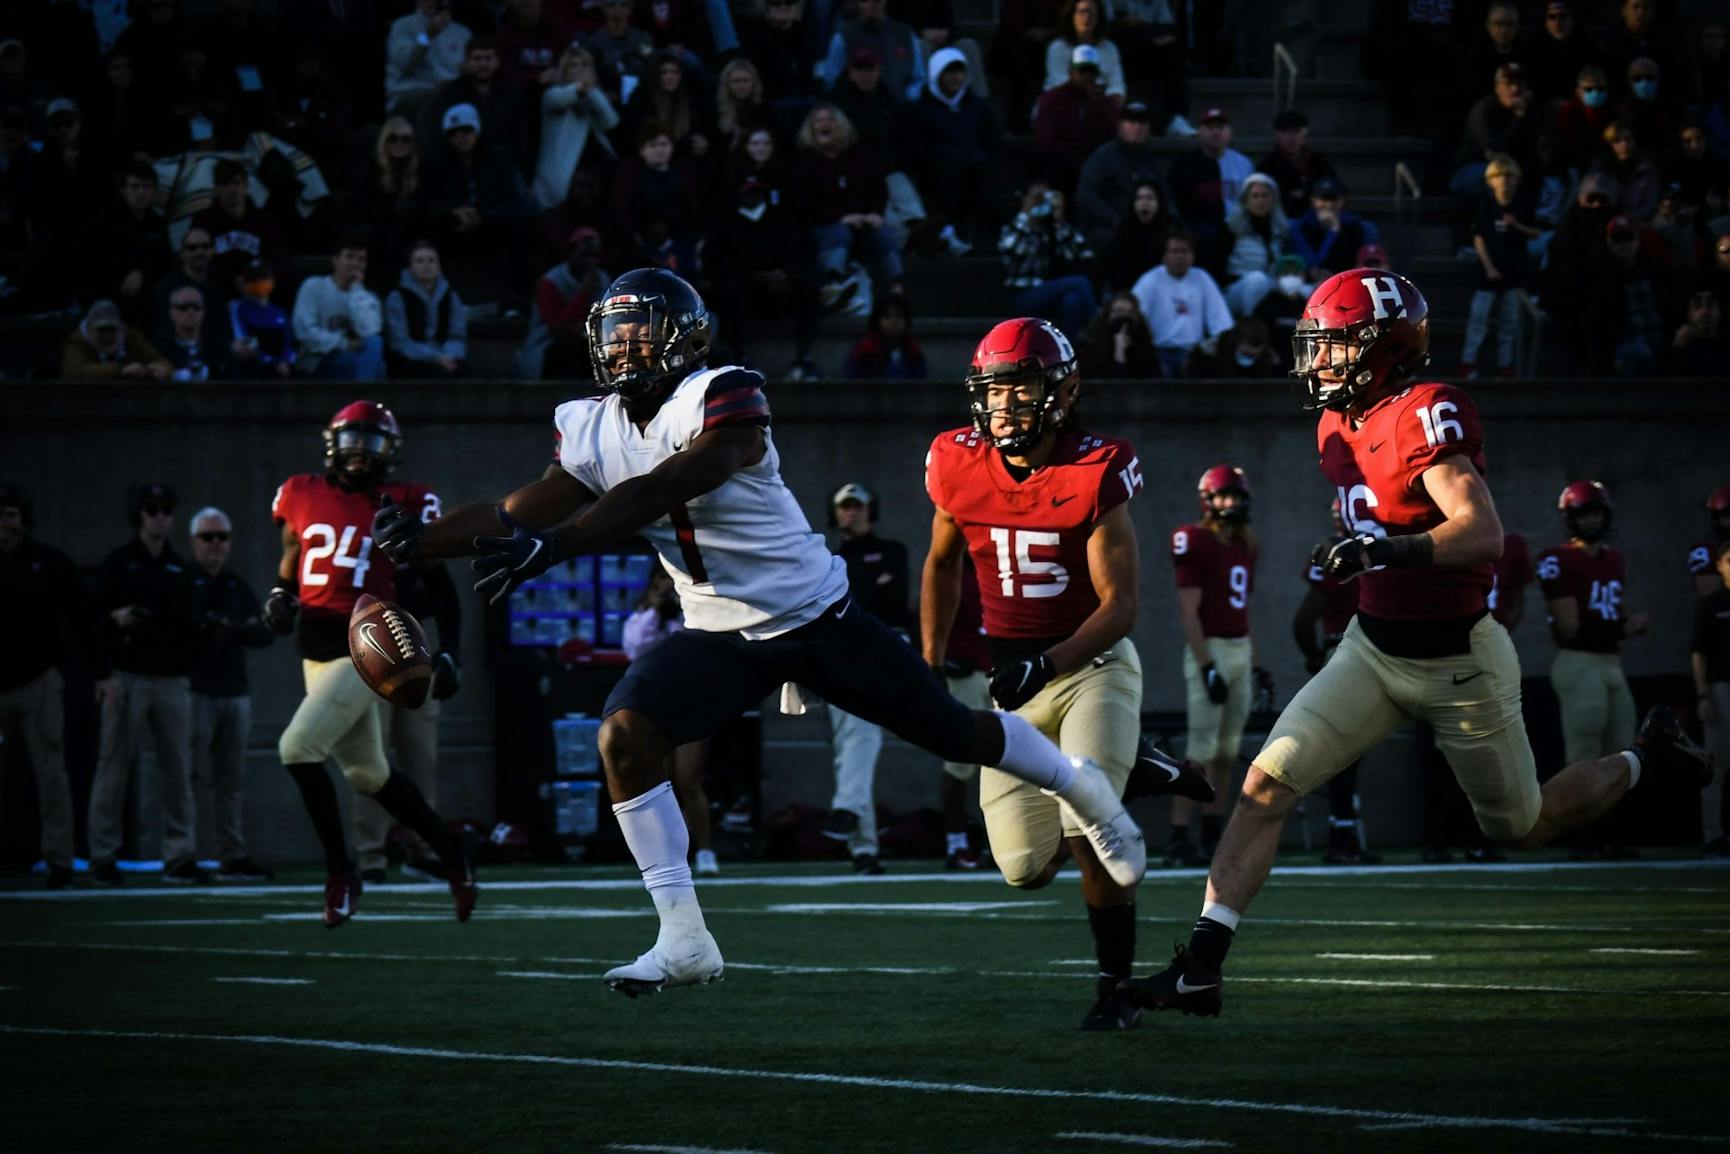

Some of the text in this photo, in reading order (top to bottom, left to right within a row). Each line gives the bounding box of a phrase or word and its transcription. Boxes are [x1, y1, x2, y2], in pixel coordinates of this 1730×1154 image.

[1361, 276, 1407, 321] H
[1416, 400, 1464, 449] 16
[1118, 456, 1144, 500] 15
[1337, 483, 1390, 537] 16
[302, 523, 373, 588] 24
[990, 526, 1071, 598] 15
[1173, 531, 1188, 555] 9
[1228, 564, 1248, 610] 9
